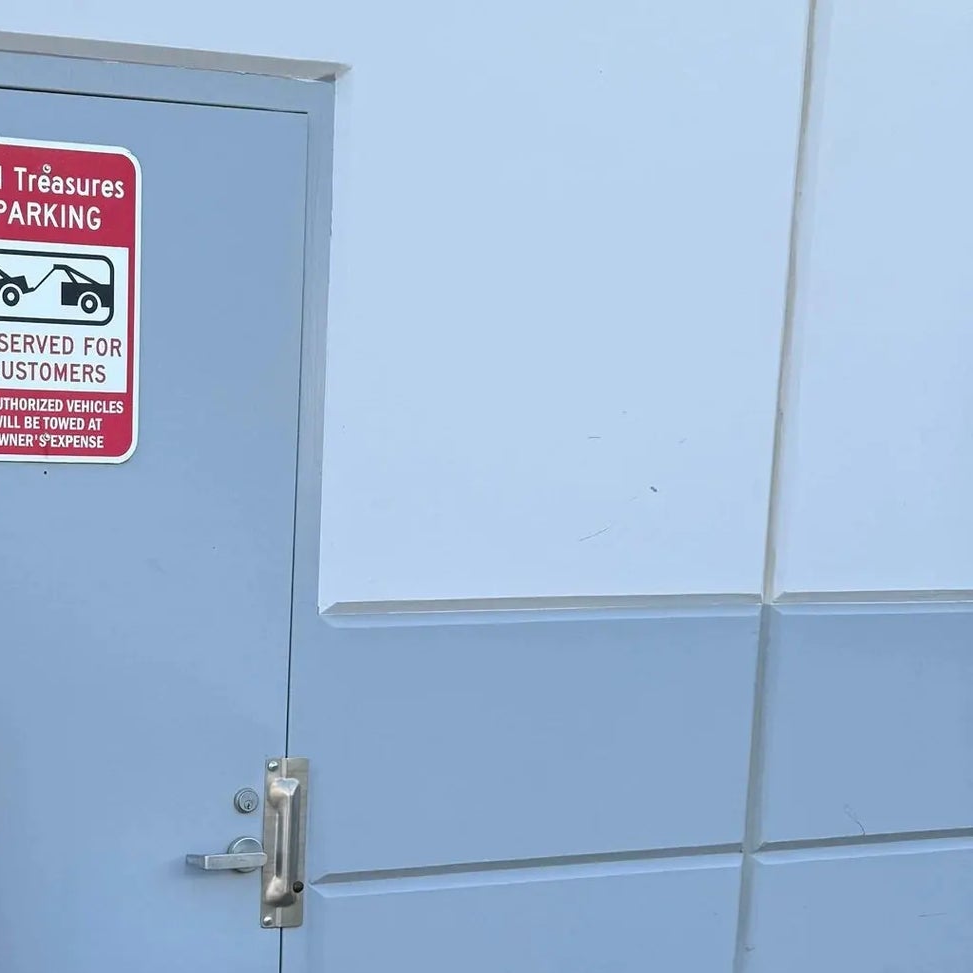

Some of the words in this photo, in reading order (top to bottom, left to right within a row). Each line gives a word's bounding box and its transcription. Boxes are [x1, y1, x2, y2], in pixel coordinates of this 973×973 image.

[13, 166, 125, 199] Treasures
[84, 336, 122, 357] FOR
[66, 398, 124, 414] VEHICLES
[24, 416, 40, 430] BE
[42, 416, 85, 431] TOWED
[87, 417, 103, 431] AT
[50, 434, 104, 449] EXPENSE
